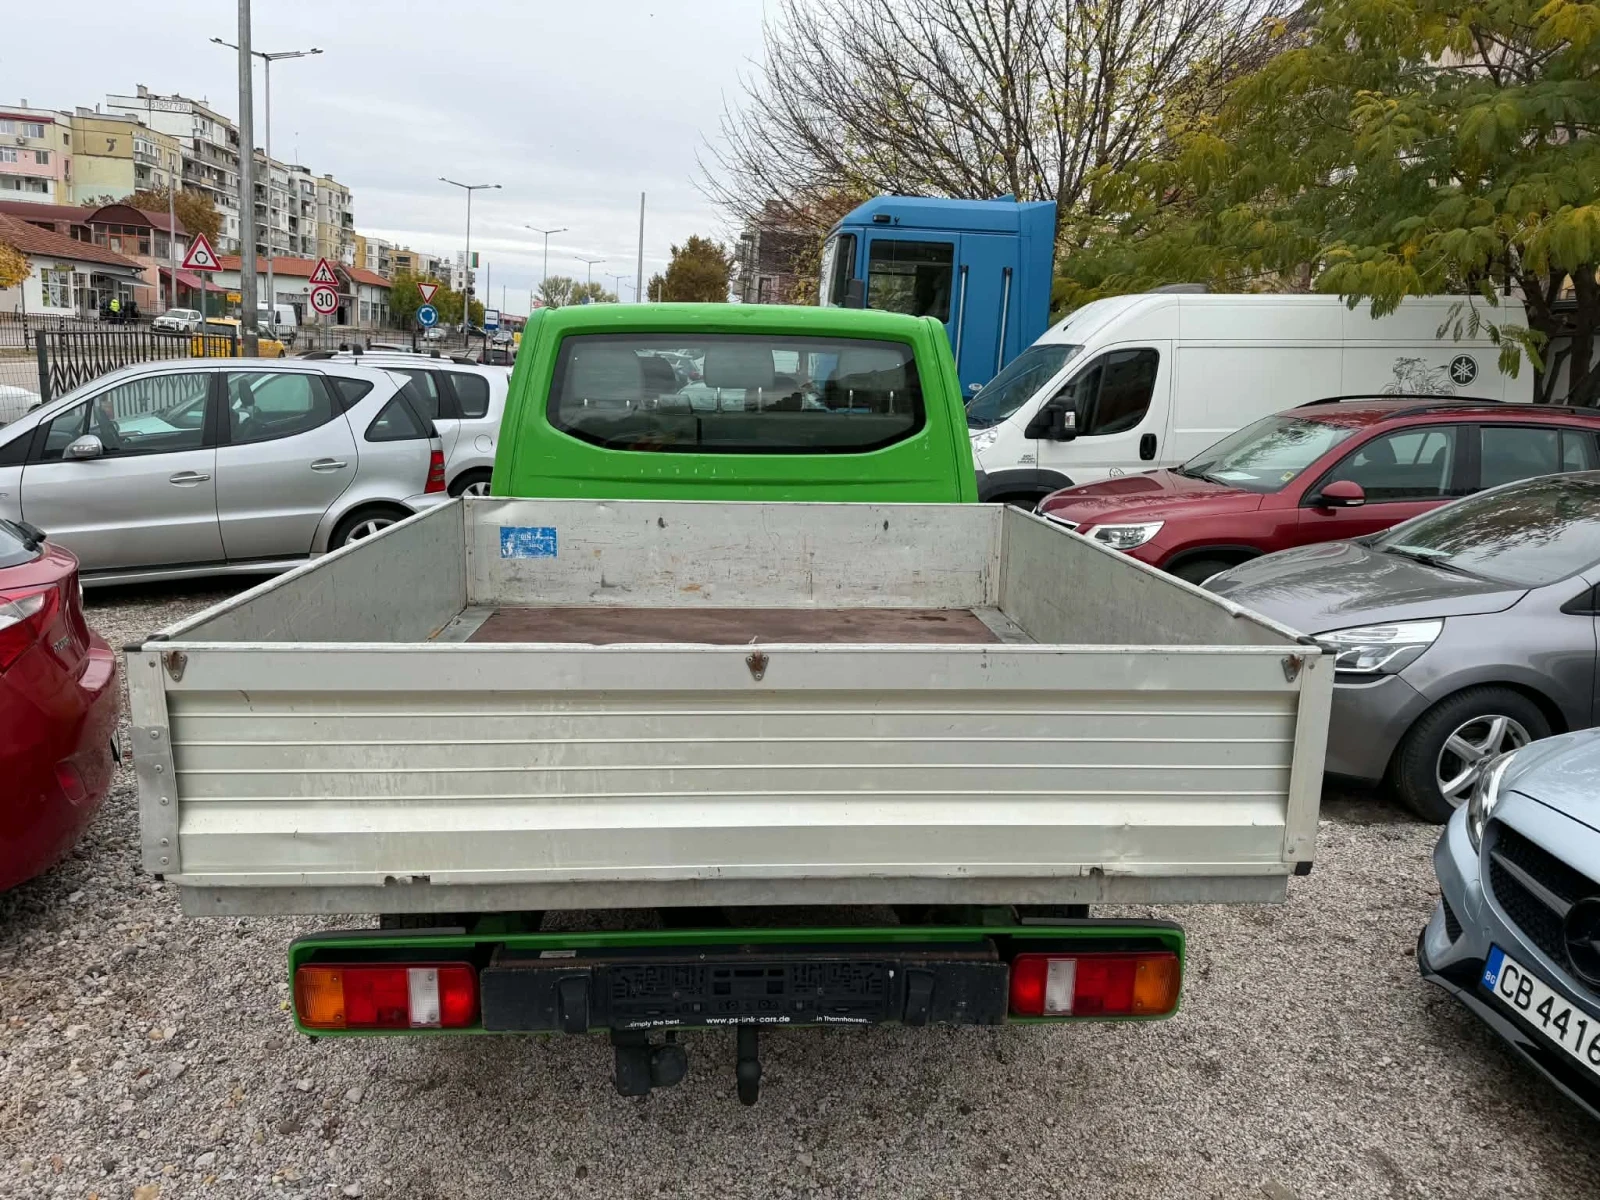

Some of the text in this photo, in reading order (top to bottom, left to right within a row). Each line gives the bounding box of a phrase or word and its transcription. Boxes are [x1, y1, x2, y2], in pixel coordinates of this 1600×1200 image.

[317, 293, 333, 307] 30
[1485, 971, 1496, 984] BG
[1500, 964, 1600, 1066] CB 4416
